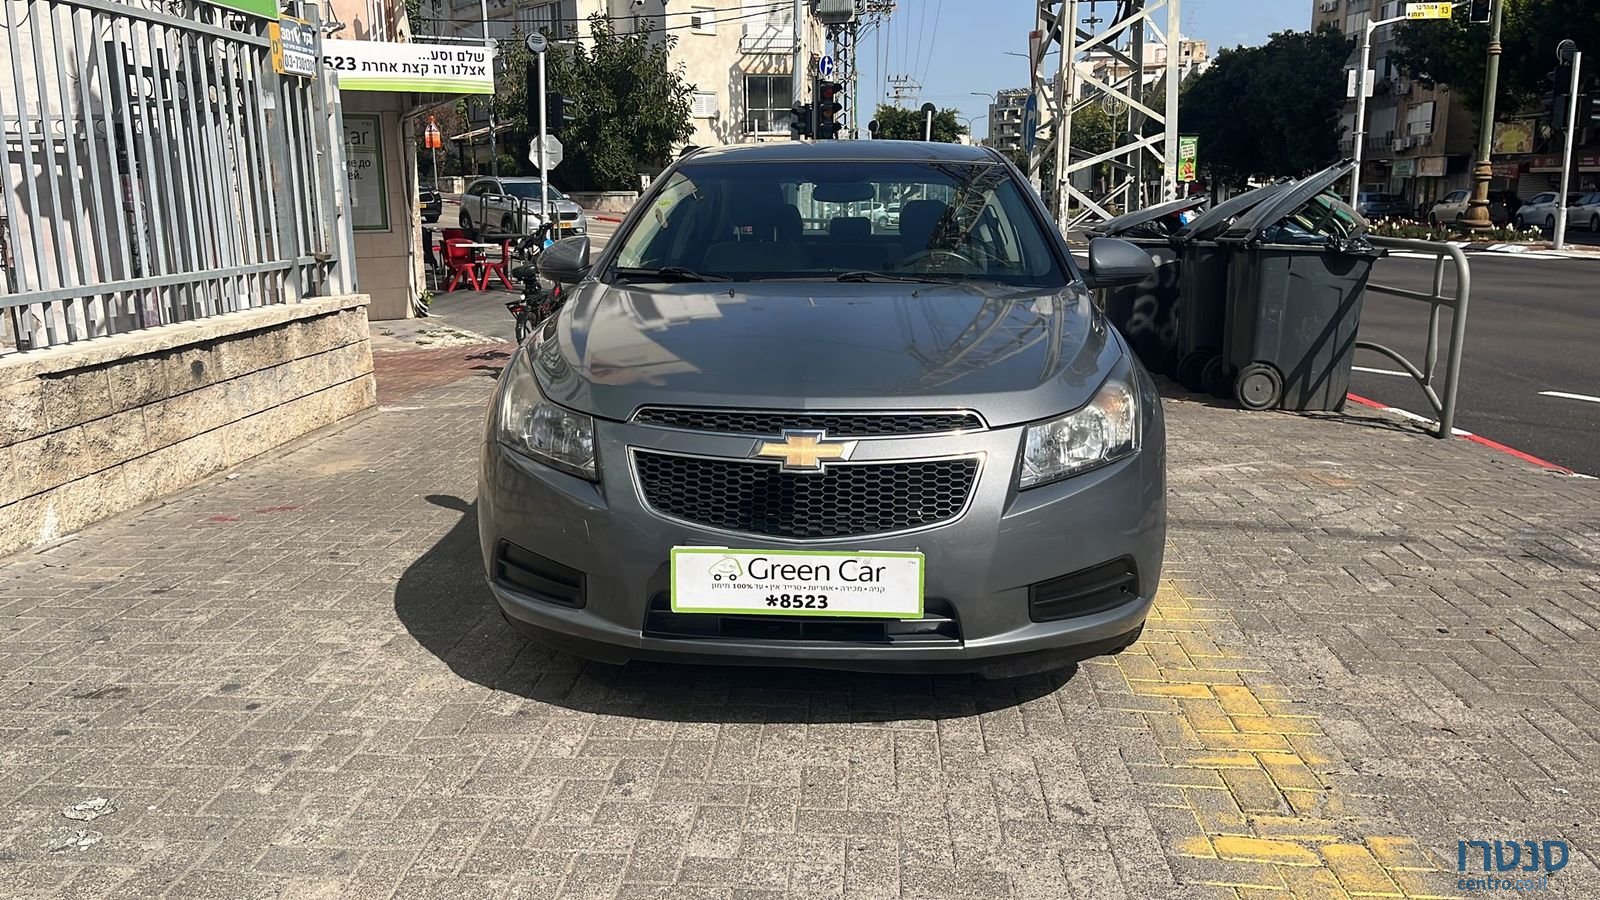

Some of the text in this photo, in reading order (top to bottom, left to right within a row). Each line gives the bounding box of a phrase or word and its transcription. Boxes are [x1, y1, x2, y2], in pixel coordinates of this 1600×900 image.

[1441, 6, 1449, 14] 13
[418, 50, 485, 63] שלם וסע...
[361, 61, 486, 76] אצלנו זה קצת אחרת
[747, 557, 886, 583] Green Car
